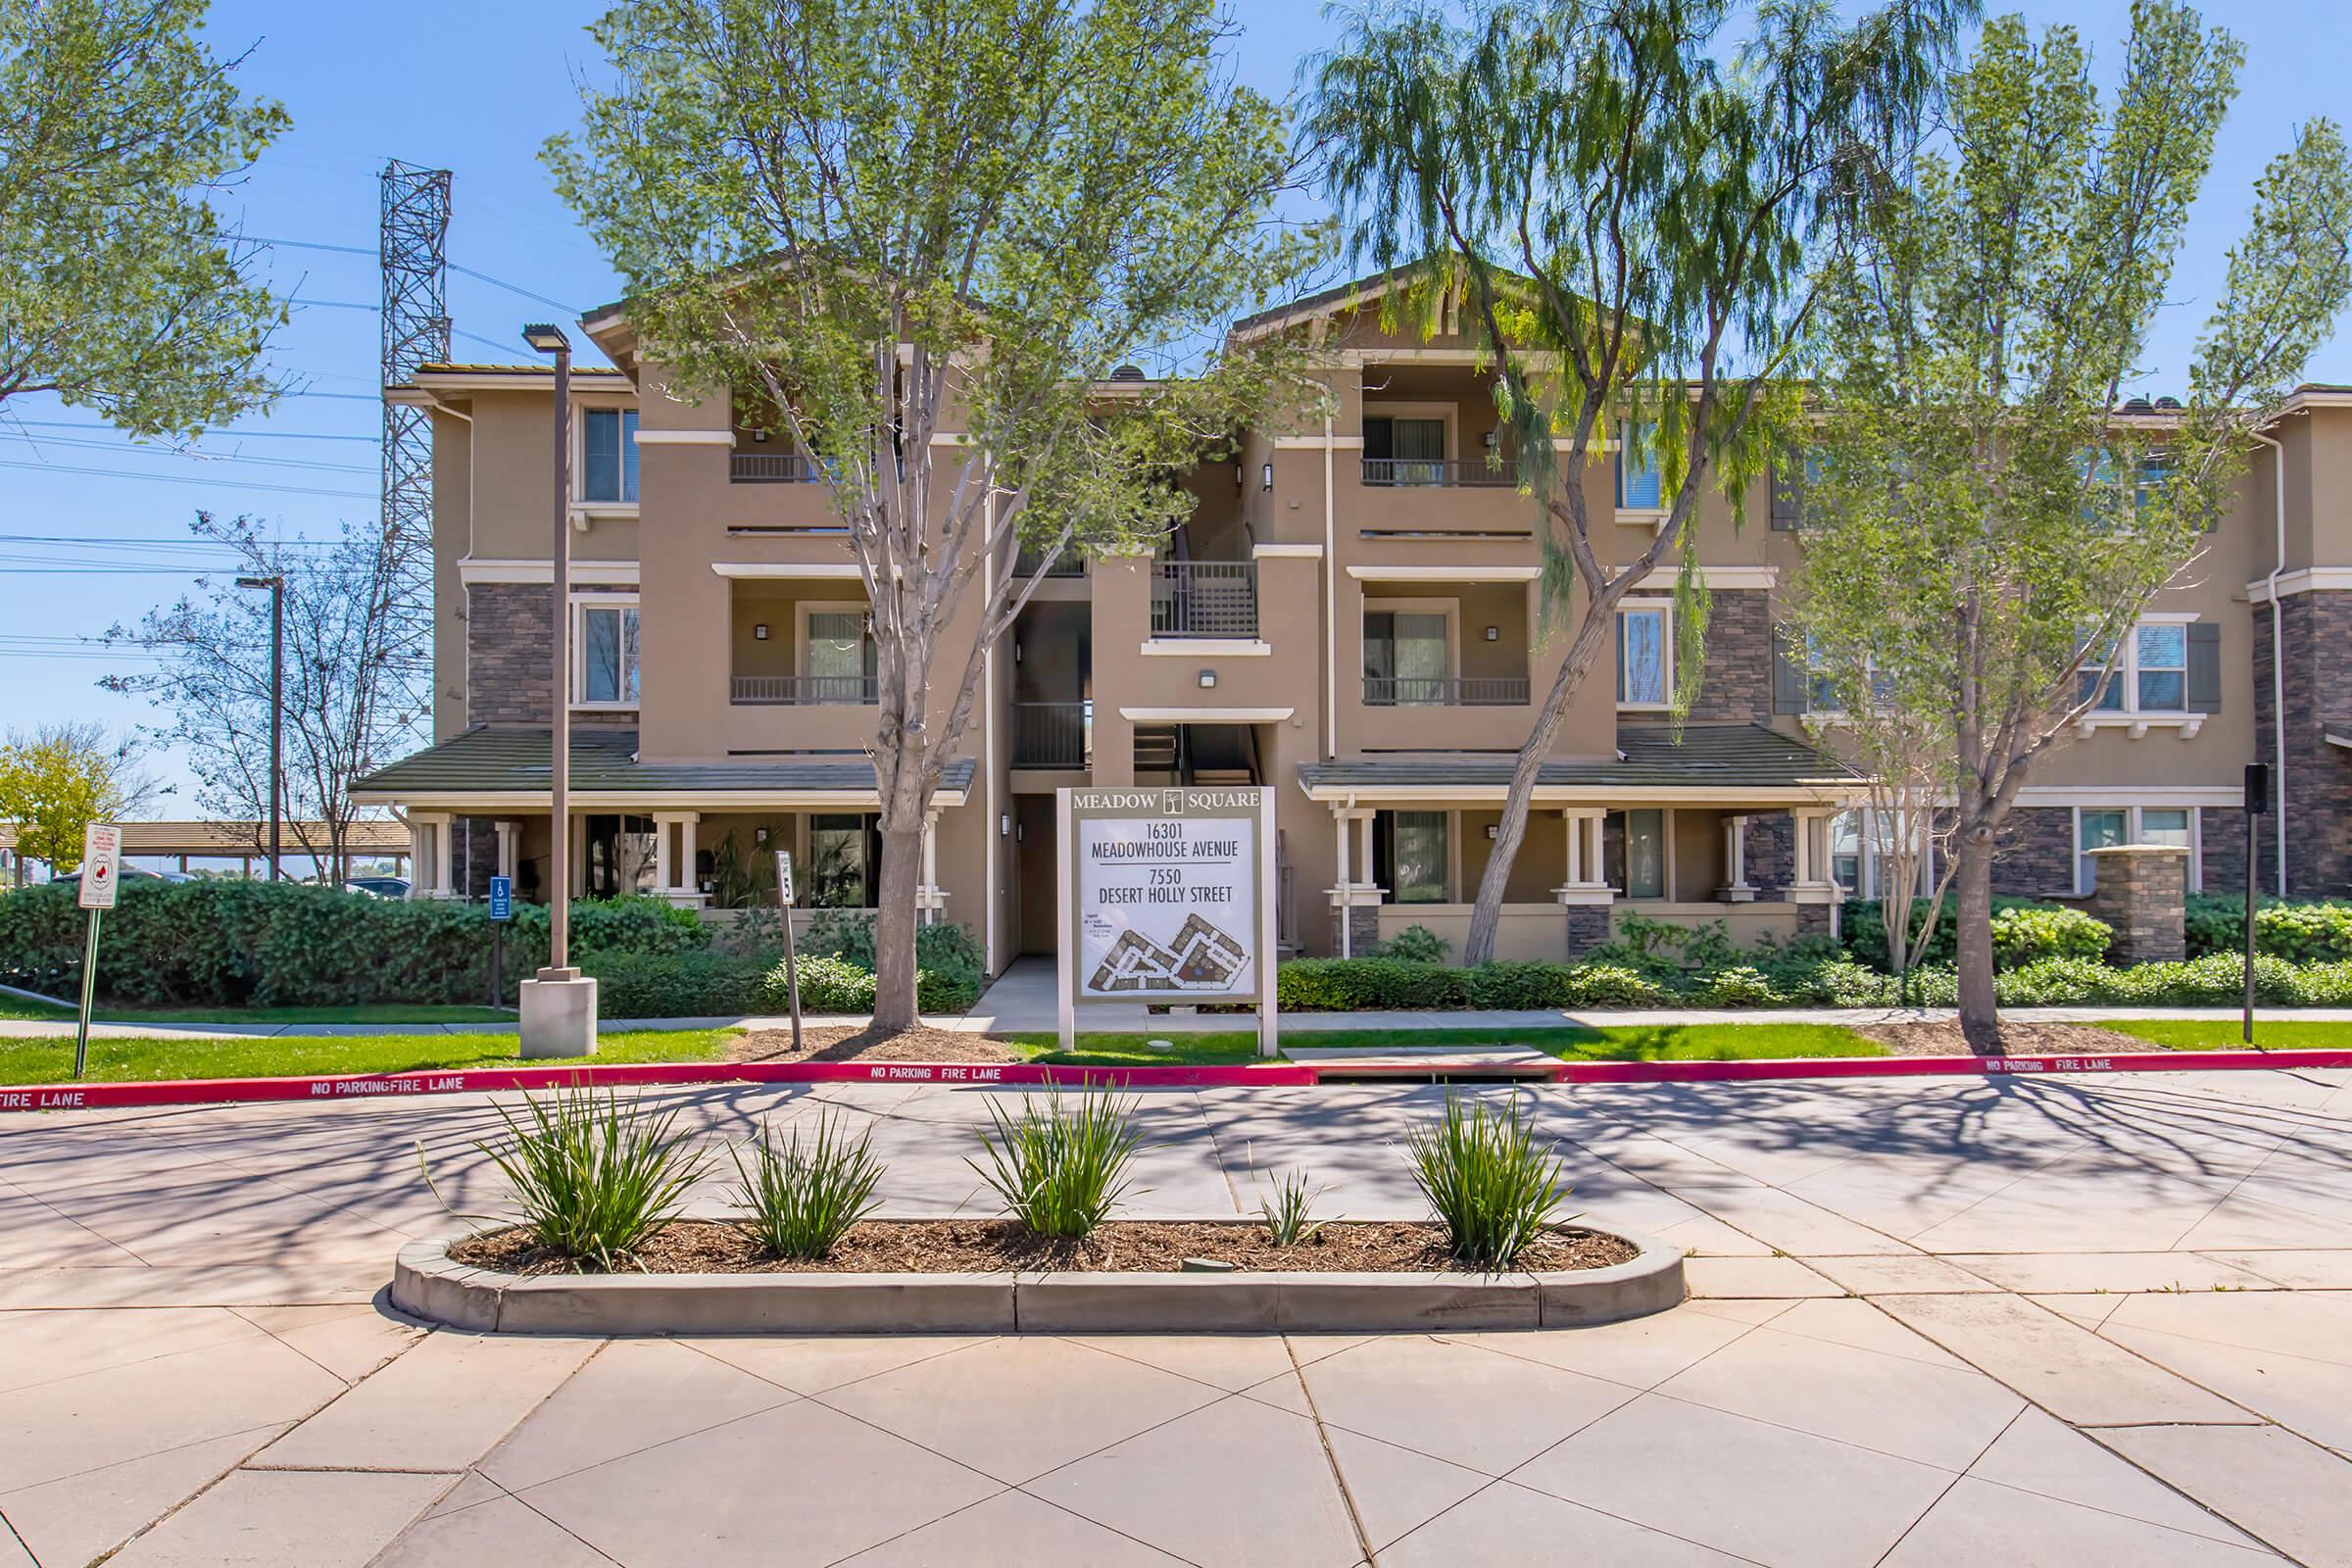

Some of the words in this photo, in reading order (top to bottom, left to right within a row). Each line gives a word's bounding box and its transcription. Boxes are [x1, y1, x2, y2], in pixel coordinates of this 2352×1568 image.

[1073, 794, 1157, 809] MEADOW
[1188, 792, 1260, 810] SQUARE
[1146, 822, 1183, 840] 16301
[1092, 841, 1188, 858] MEADOWHOUSE
[1192, 840, 1239, 858] AVENUE
[1149, 868, 1182, 885] 7550
[1099, 887, 1144, 904] DESERT
[1148, 886, 1186, 904] HOLLY
[1191, 886, 1233, 903] STREET
[870, 1066, 886, 1078] NO
[889, 1066, 932, 1079] PARKING
[941, 1067, 967, 1079] FIRE
[972, 1067, 1002, 1079] LANE
[1985, 1060, 2000, 1071] NO
[2003, 1059, 2044, 1071] PARKING
[2055, 1058, 2081, 1070] FIRE
[2083, 1058, 2113, 1069] LANE
[311, 1082, 331, 1095] NO
[335, 1081, 390, 1094] PARKING
[390, 1079, 422, 1093] FIRE
[428, 1076, 465, 1091] LANE
[40, 1092, 85, 1106] LANE
